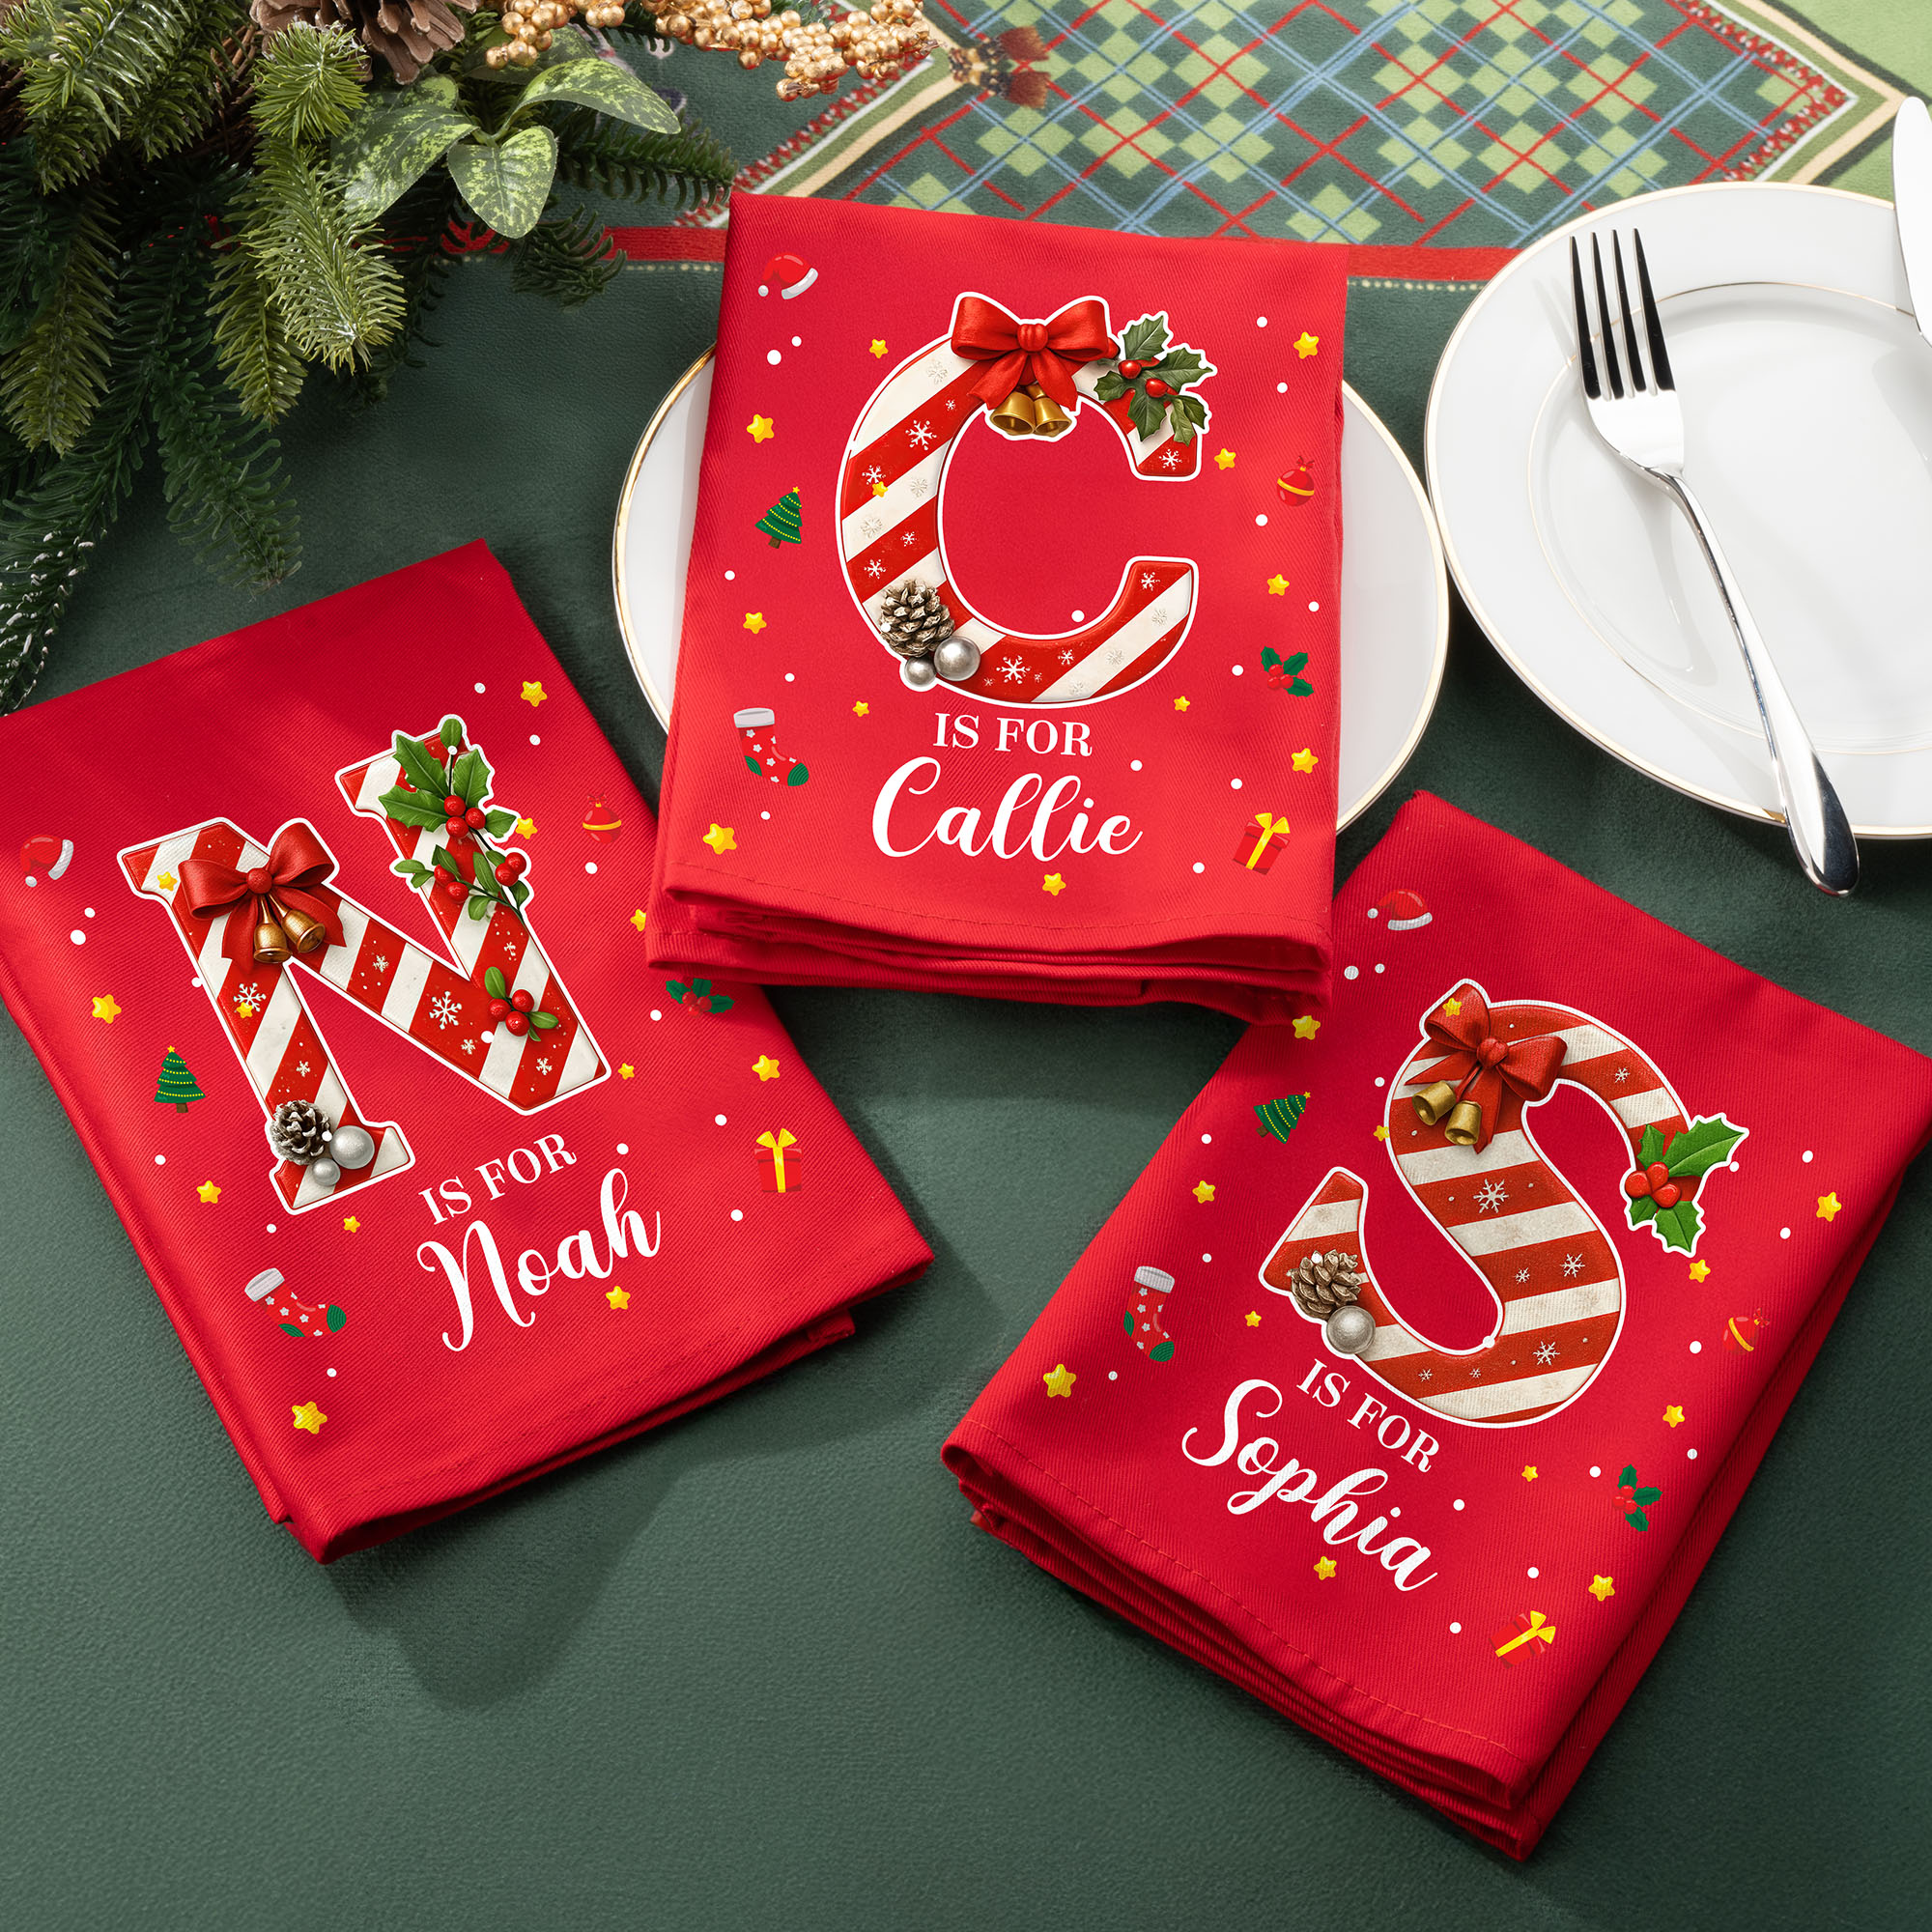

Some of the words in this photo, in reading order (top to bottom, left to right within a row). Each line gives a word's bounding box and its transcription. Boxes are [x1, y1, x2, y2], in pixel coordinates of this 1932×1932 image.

[836, 292, 1208, 709] C
[872, 756, 1143, 862] Callie
[933, 713, 979, 750] IS
[995, 718, 1092, 756] FOR
[117, 714, 611, 1215] N
[417, 1168, 661, 1351] Noah
[418, 1176, 471, 1225] IS
[474, 1134, 577, 1200] FOR
[1259, 979, 1729, 1429] S
[1182, 1379, 1437, 1591] Sophia
[1296, 1359, 1350, 1406] IS
[1348, 1393, 1438, 1472] FOR
